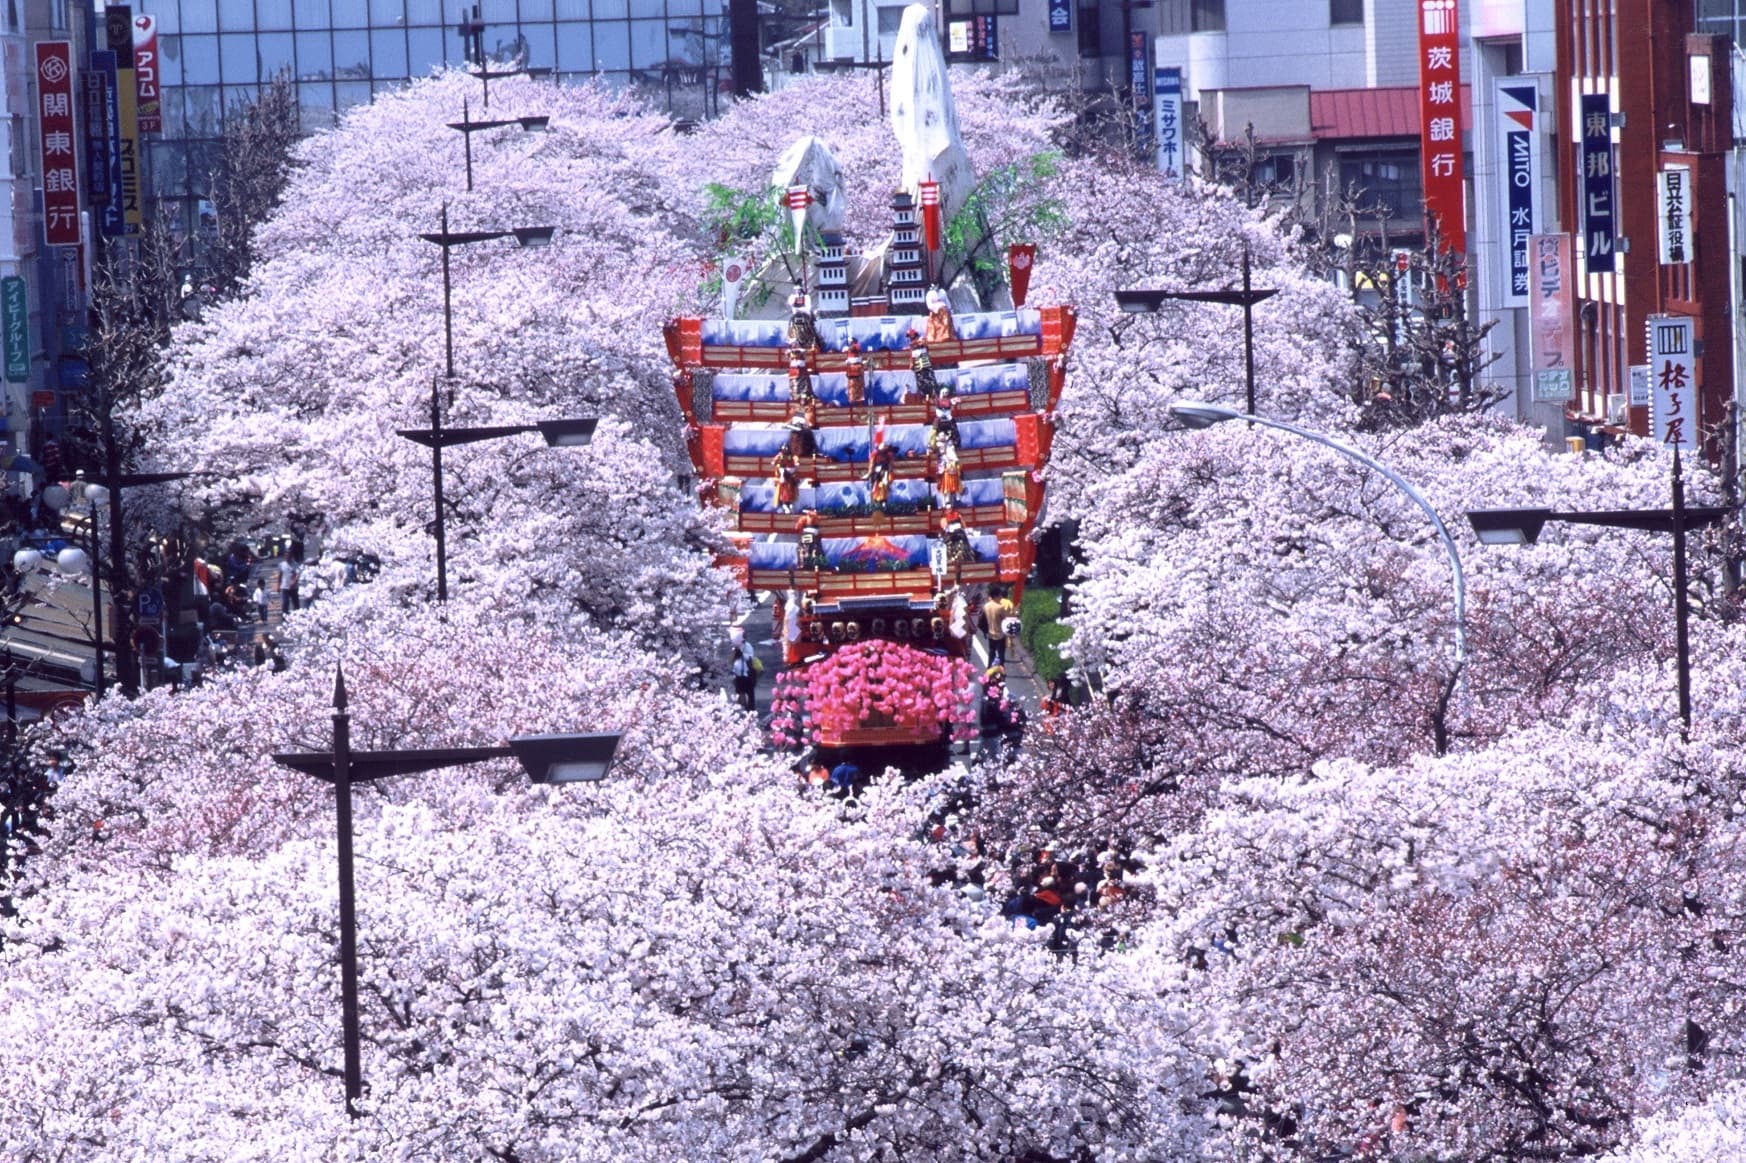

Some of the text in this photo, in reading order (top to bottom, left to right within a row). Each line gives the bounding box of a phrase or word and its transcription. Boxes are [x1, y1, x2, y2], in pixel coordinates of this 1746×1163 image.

[137, 51, 155, 97] アコム
[1428, 47, 1455, 177] 茨城銀行
[43, 93, 76, 230] 関東銀行
[1161, 100, 1178, 178] ミサワホーム
[1513, 136, 1530, 187] MITO
[1585, 111, 1611, 257] 東邦ビル
[1666, 173, 1684, 262] 日立公証役場
[7, 281, 22, 362] アイビーグループ
[1658, 360, 1690, 443] 格子屋
